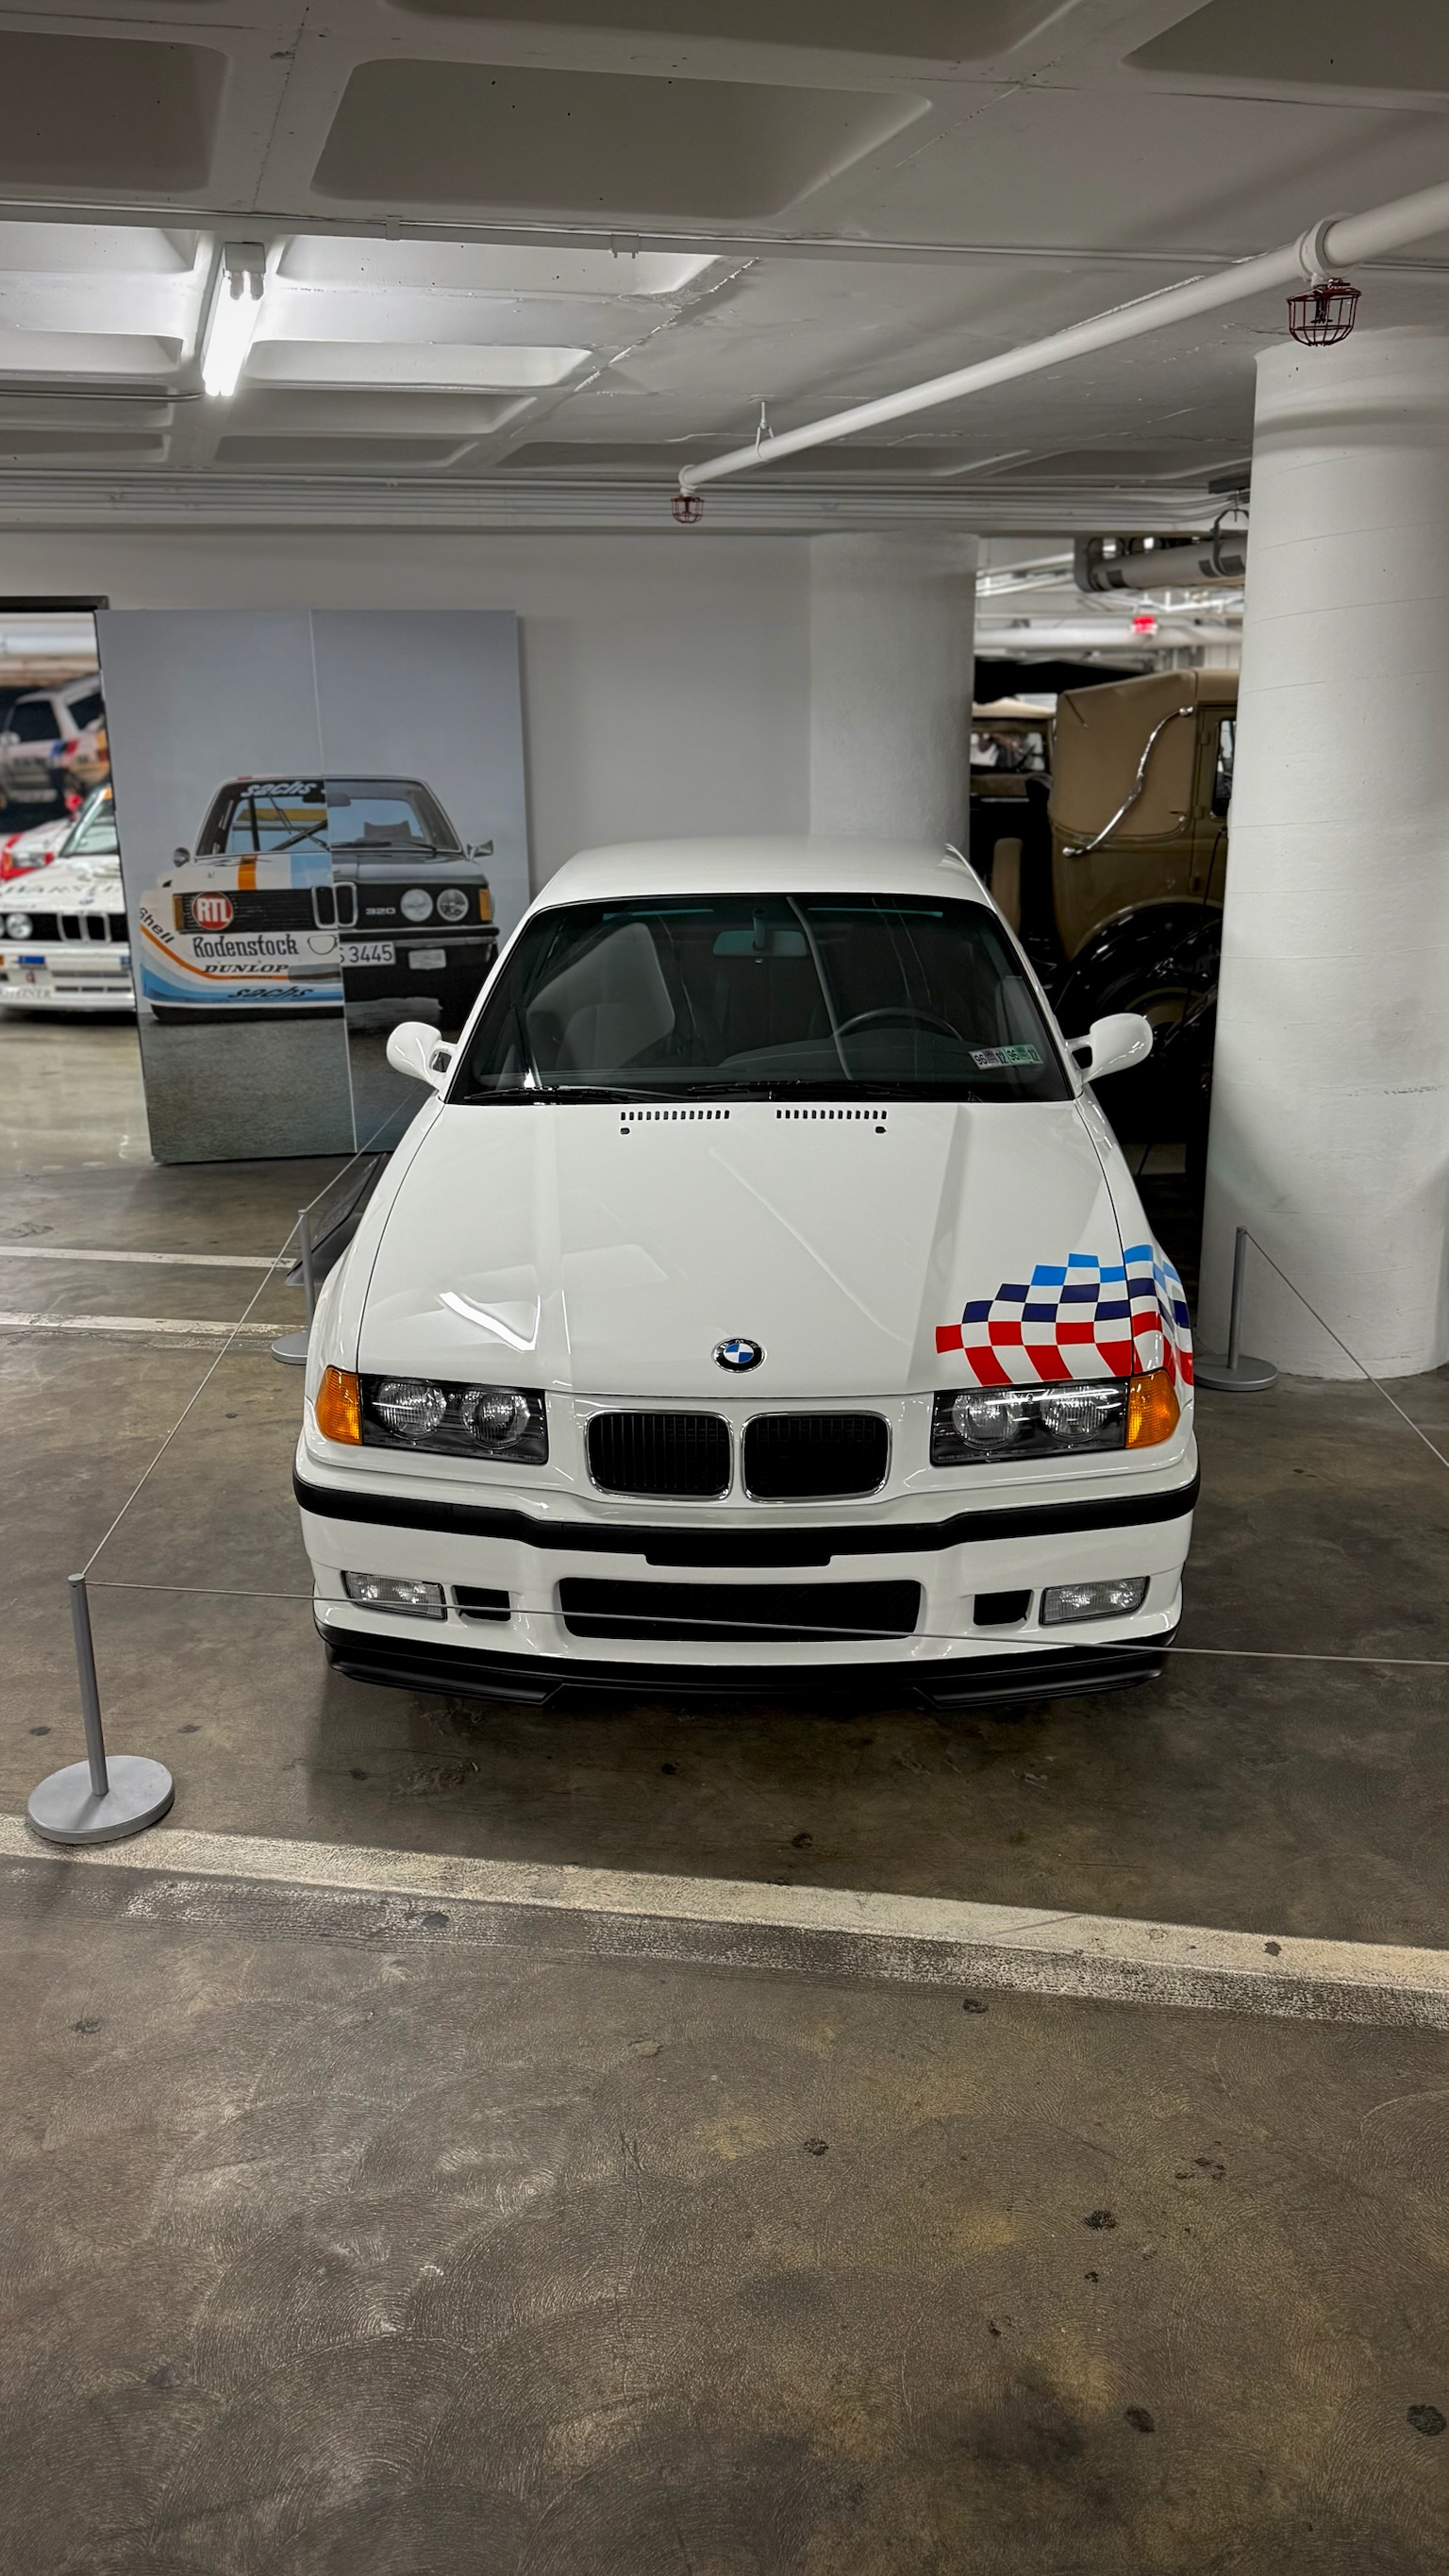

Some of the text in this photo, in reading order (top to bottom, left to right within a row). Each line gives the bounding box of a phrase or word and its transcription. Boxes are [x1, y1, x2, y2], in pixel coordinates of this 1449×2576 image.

[241, 781, 317, 797] sachs
[196, 897, 229, 923] RTL
[140, 907, 175, 944] Shell
[192, 933, 300, 958] Rodenstock
[348, 945, 392, 963] 3445
[203, 964, 289, 973] DUNLOP
[227, 986, 314, 998] sachs
[974, 1054, 988, 1065] 96
